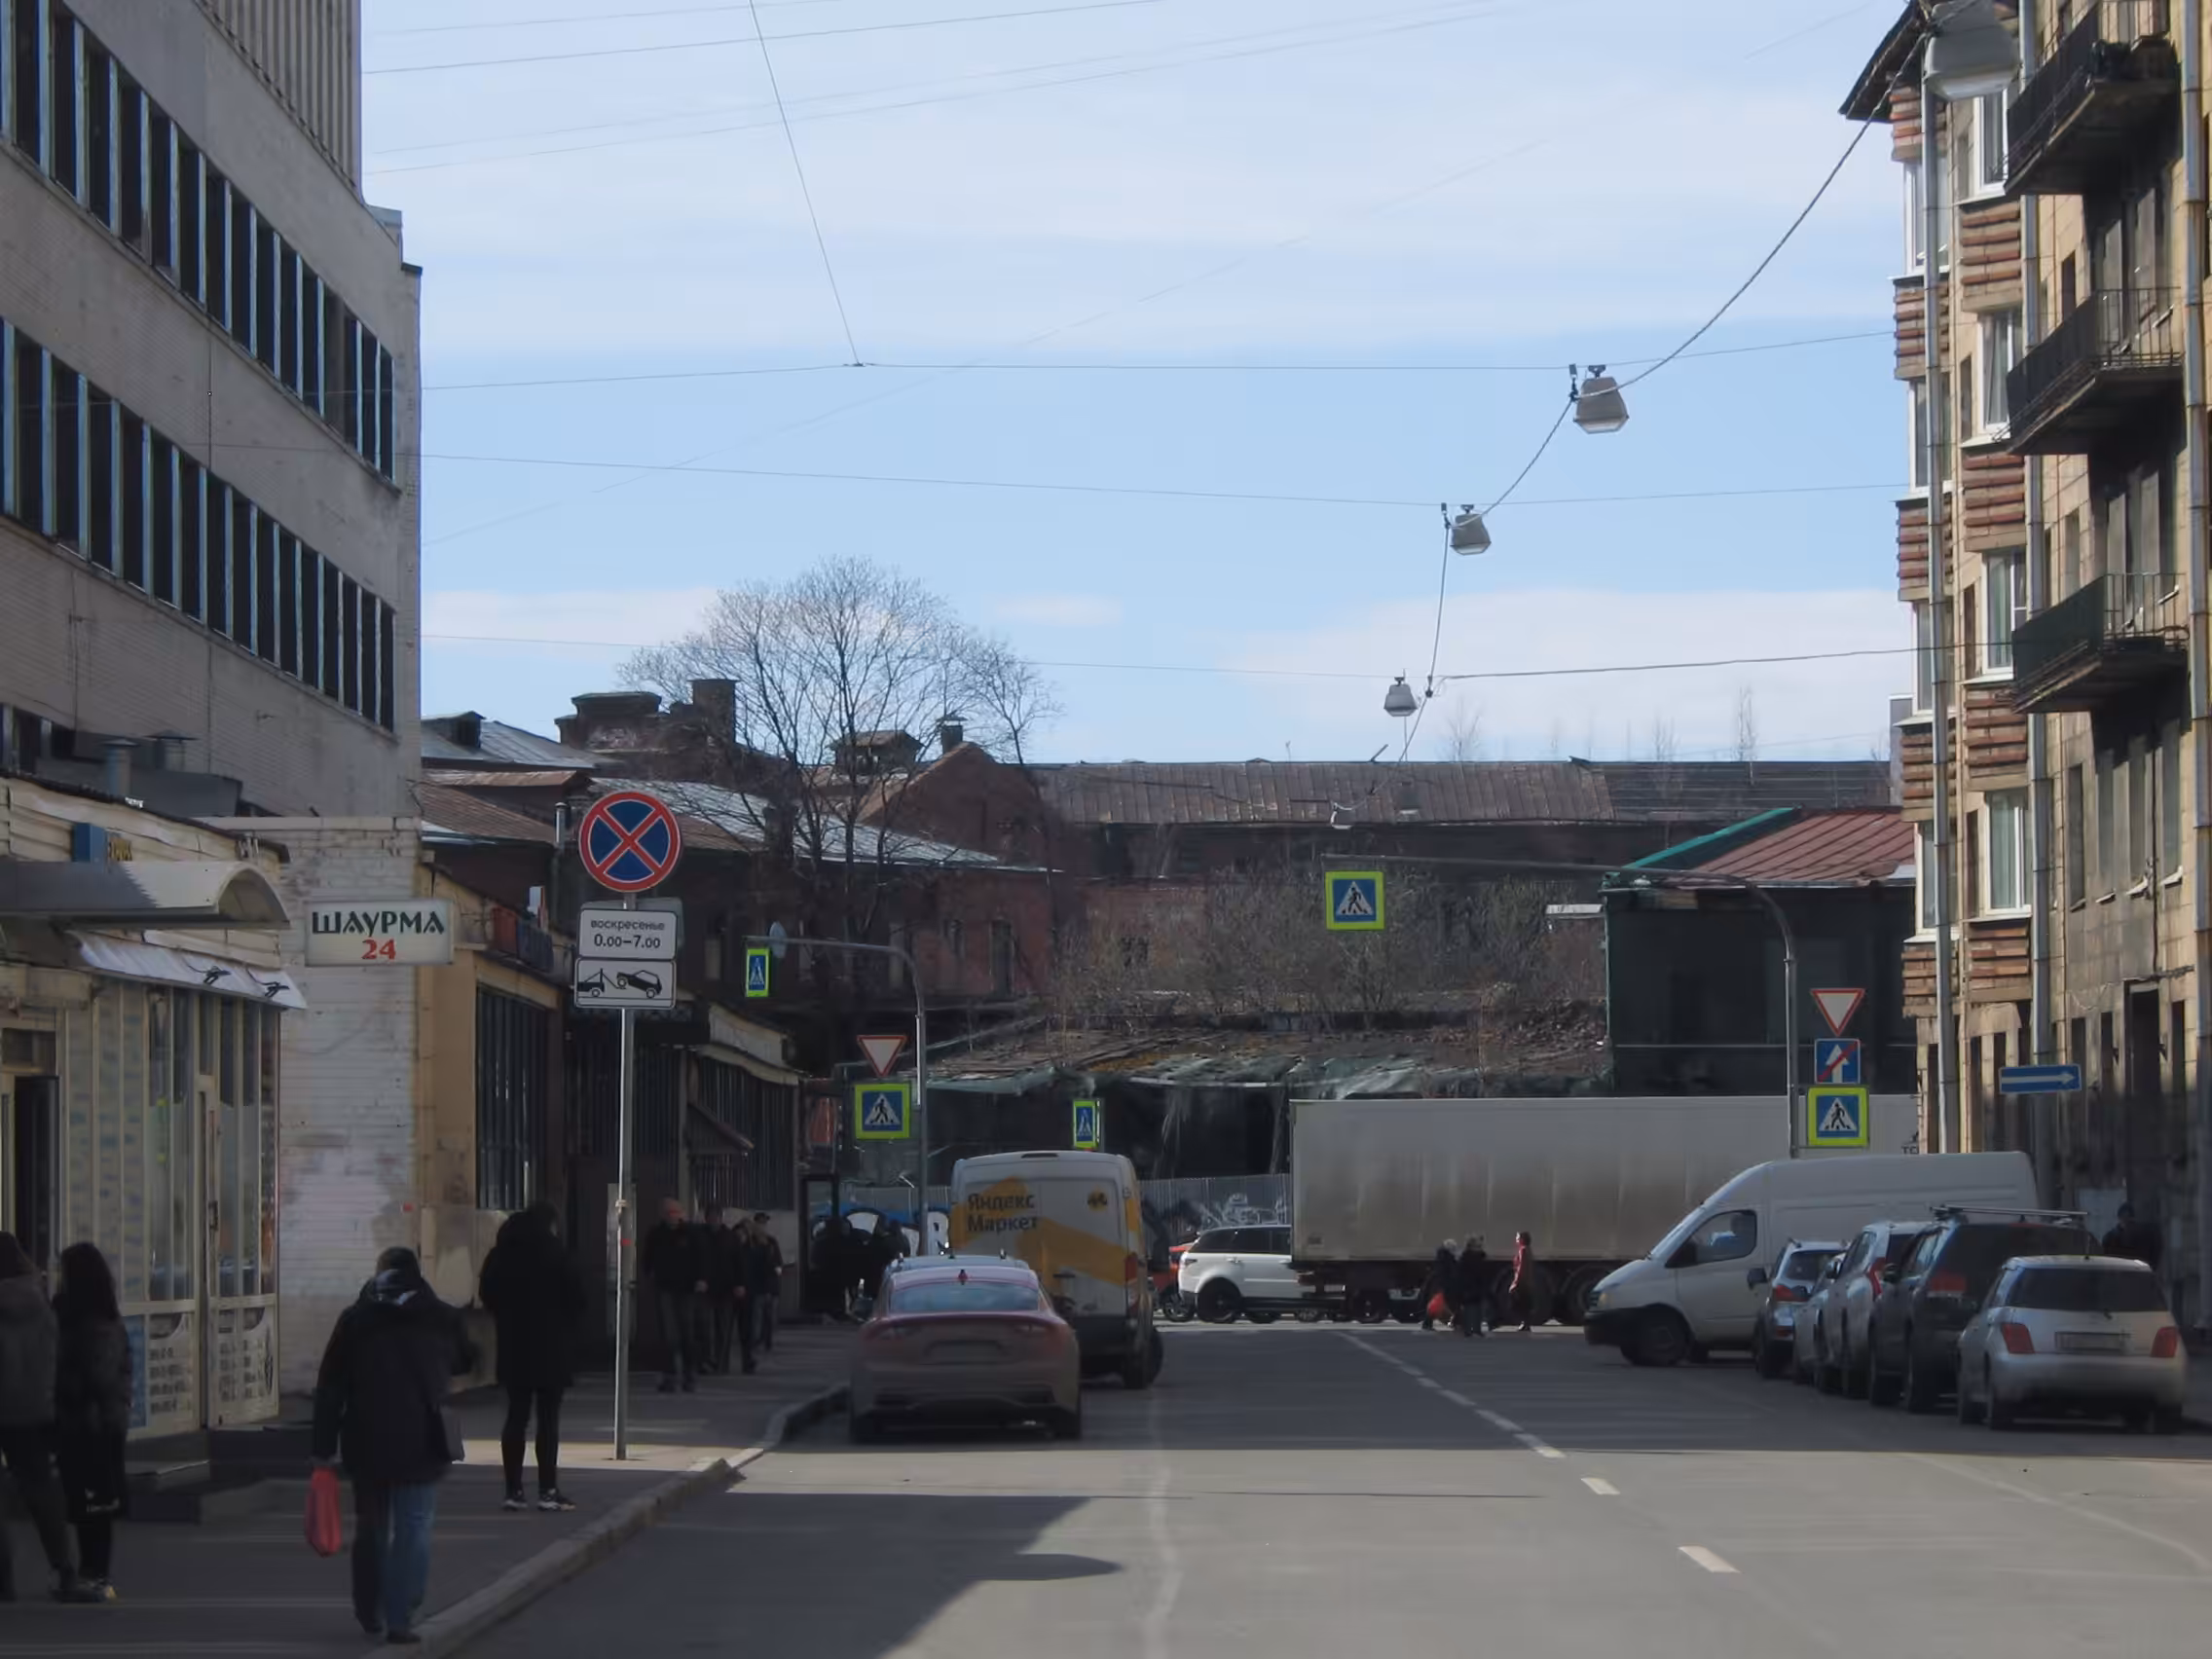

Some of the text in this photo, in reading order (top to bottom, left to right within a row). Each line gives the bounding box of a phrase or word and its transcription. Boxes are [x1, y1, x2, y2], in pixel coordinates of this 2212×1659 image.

[312, 910, 445, 937] ШАУРМА
[590, 920, 665, 932] воскресенье
[361, 939, 396, 960] 24
[968, 1193, 1035, 1212] Яндекс
[967, 1213, 1038, 1235] Маркет
